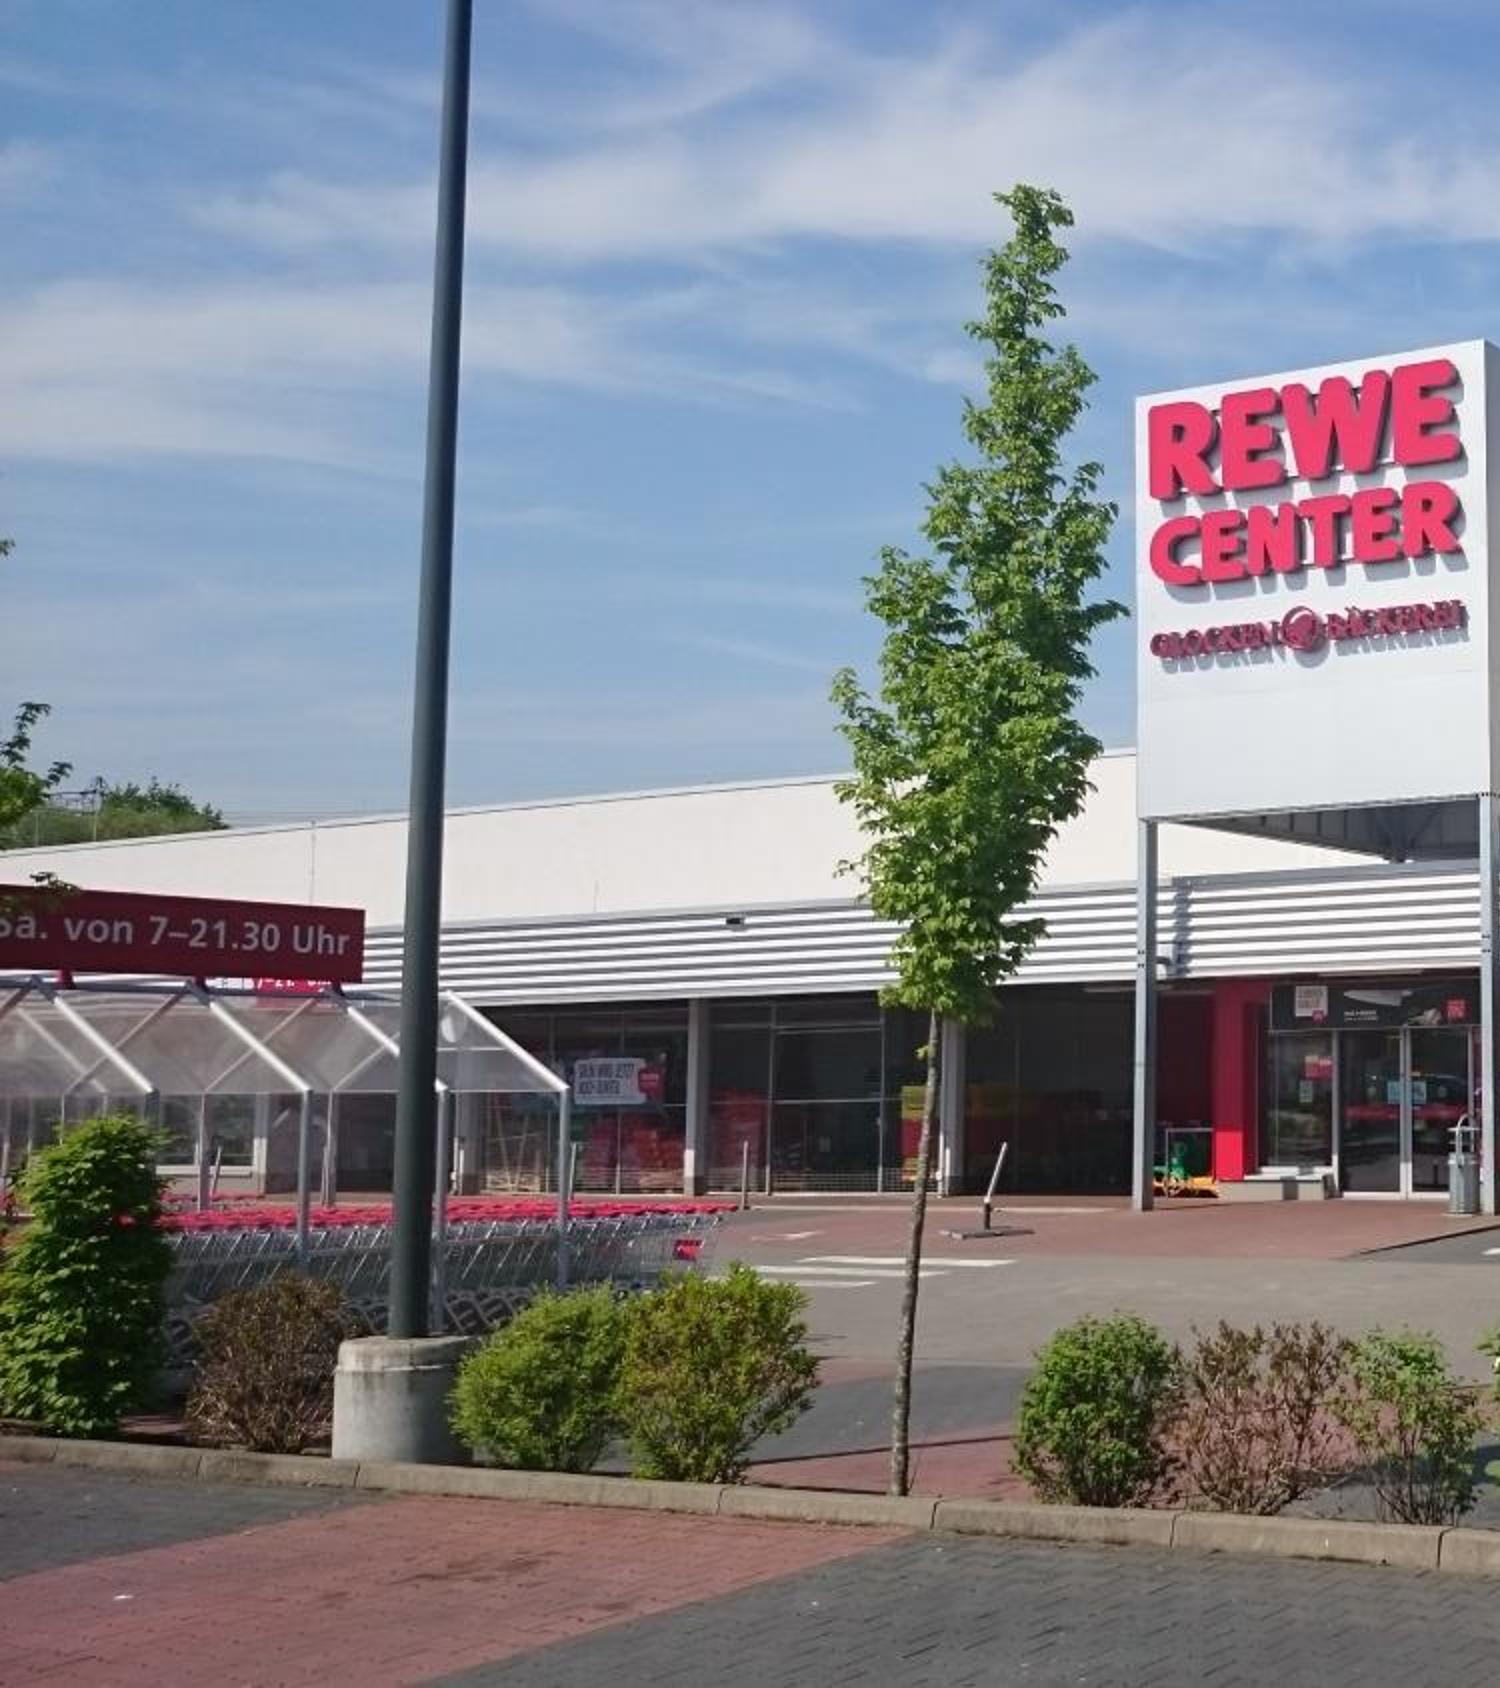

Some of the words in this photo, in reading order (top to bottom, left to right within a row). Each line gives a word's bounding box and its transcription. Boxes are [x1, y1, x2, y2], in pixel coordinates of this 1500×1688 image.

[1148, 359, 1462, 500] REWE
[1150, 481, 1461, 585] CENTER
[64, 918, 133, 944] von
[149, 915, 281, 952] 7–21.30
[292, 925, 350, 955] Uhr
